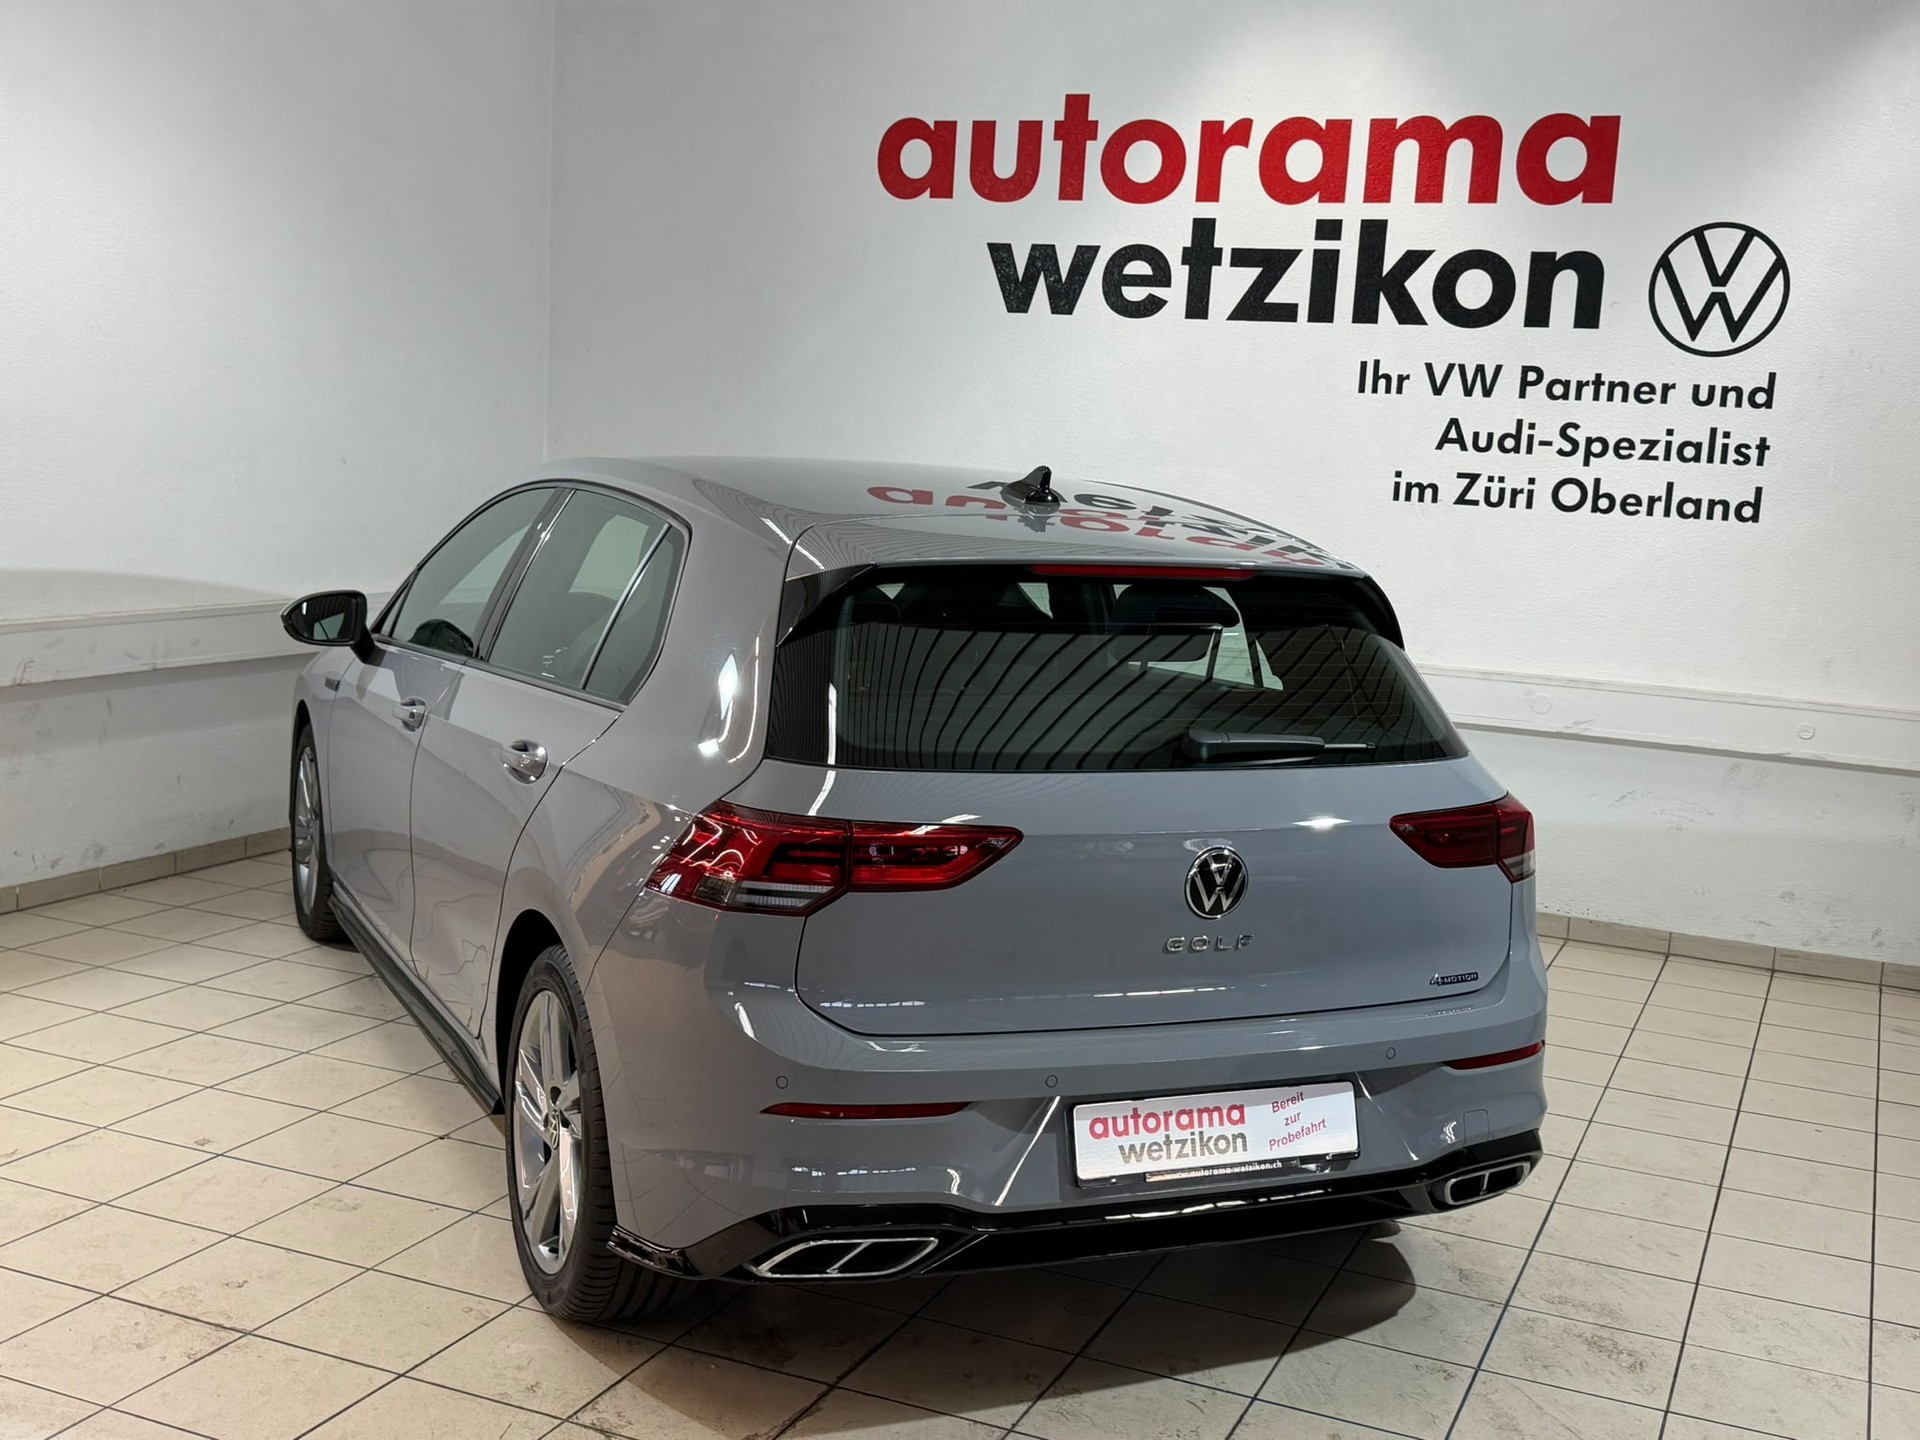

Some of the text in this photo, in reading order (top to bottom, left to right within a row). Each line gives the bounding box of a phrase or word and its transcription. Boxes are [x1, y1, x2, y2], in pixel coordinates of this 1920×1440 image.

[879, 95, 1620, 205] autorama
[987, 218, 1604, 329] wetzikon
[1358, 359, 1777, 410] Ihr VW Partner und
[1435, 417, 1770, 467] Audi-Spezialist
[1393, 470, 1763, 521] im Züri Oberland
[1165, 933, 1255, 952] GOLF
[1272, 1090, 1304, 1113] Bereit
[1284, 1112, 1302, 1126] zur
[1089, 1103, 1245, 1139] autorama
[1268, 1118, 1326, 1151] Probefahrt
[1118, 1131, 1248, 1164] wetzikon
